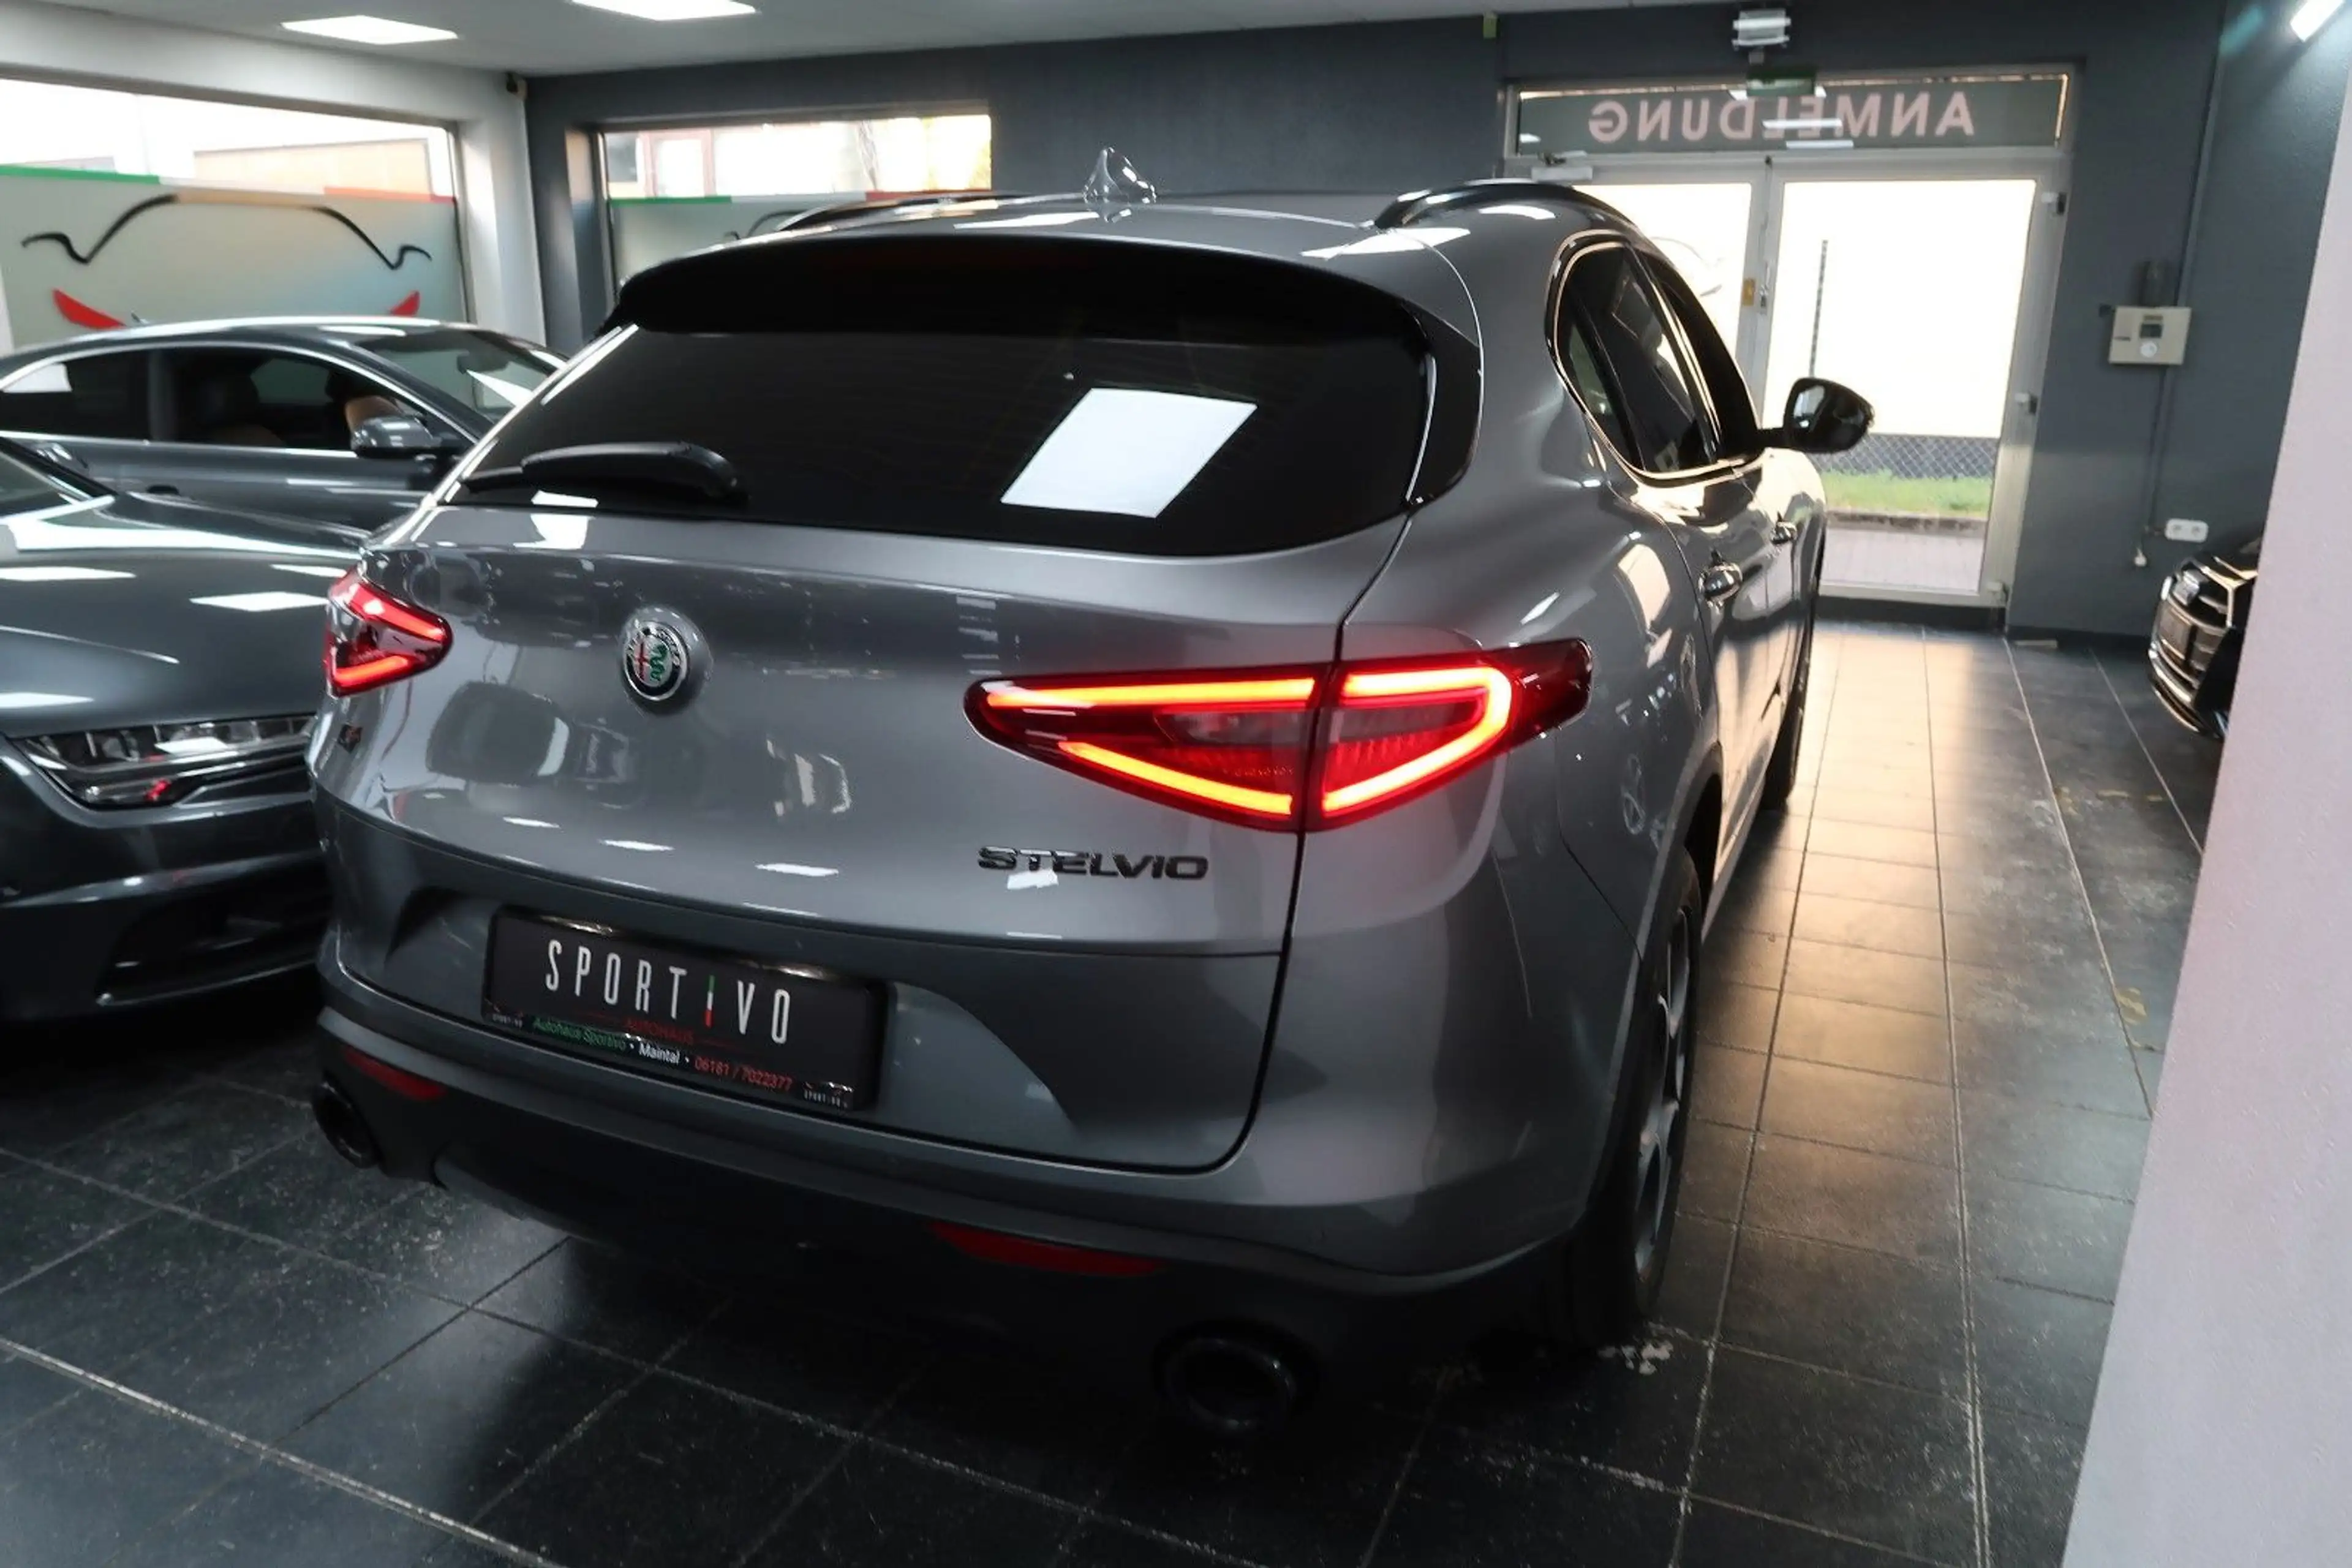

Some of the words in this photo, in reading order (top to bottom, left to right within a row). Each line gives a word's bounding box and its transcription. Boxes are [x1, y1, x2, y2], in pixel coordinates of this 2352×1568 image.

[978, 846, 1209, 880] STELVIO
[546, 939, 790, 1044] SPORTIVO
[639, 1042, 680, 1065] Maintal
